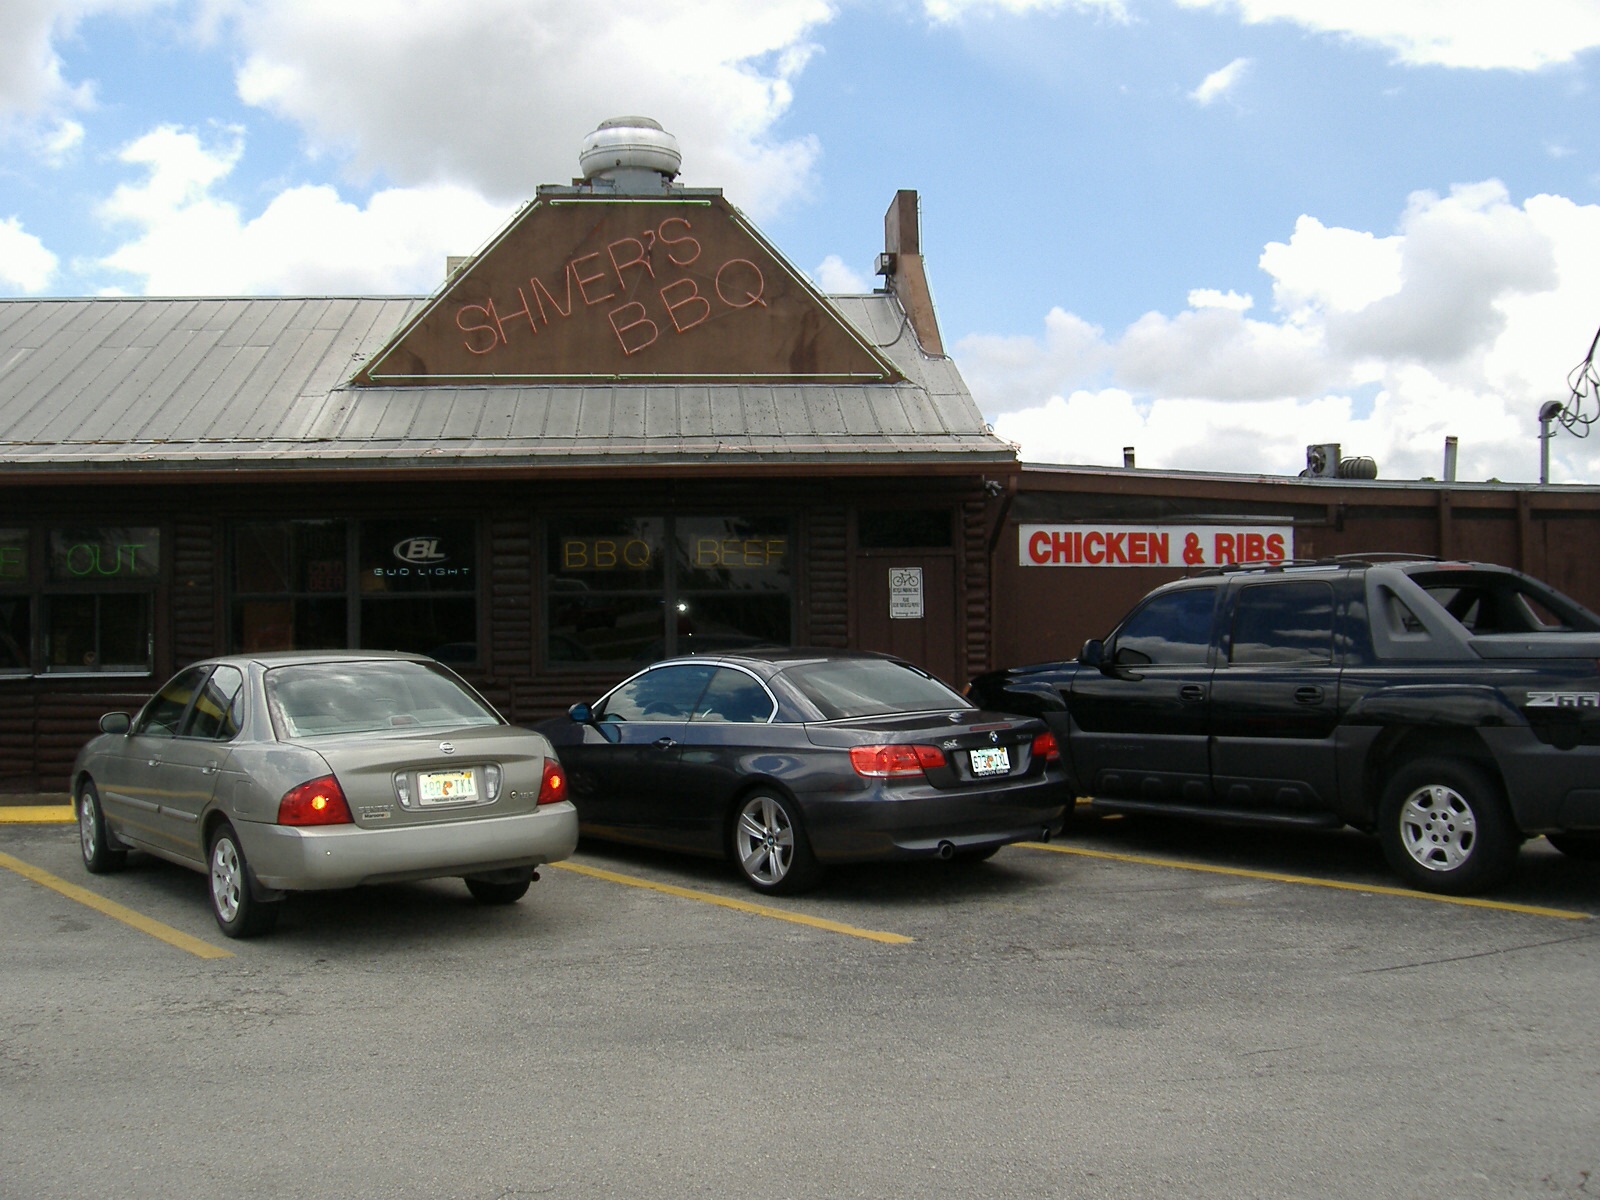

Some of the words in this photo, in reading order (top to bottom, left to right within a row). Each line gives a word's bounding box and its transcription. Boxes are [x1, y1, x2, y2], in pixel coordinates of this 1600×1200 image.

[456, 217, 701, 354] SHIVER'S
[608, 258, 767, 355] BBQ
[66, 544, 146, 576] OUT
[406, 540, 446, 558] BL
[565, 540, 650, 568] BBQ
[697, 539, 785, 566] BEEF
[1028, 531, 1169, 564] CHICKEN
[1182, 532, 1205, 564] &
[1215, 533, 1285, 565] RIBS
[373, 567, 410, 577] BUD
[417, 567, 470, 577] LIGHT
